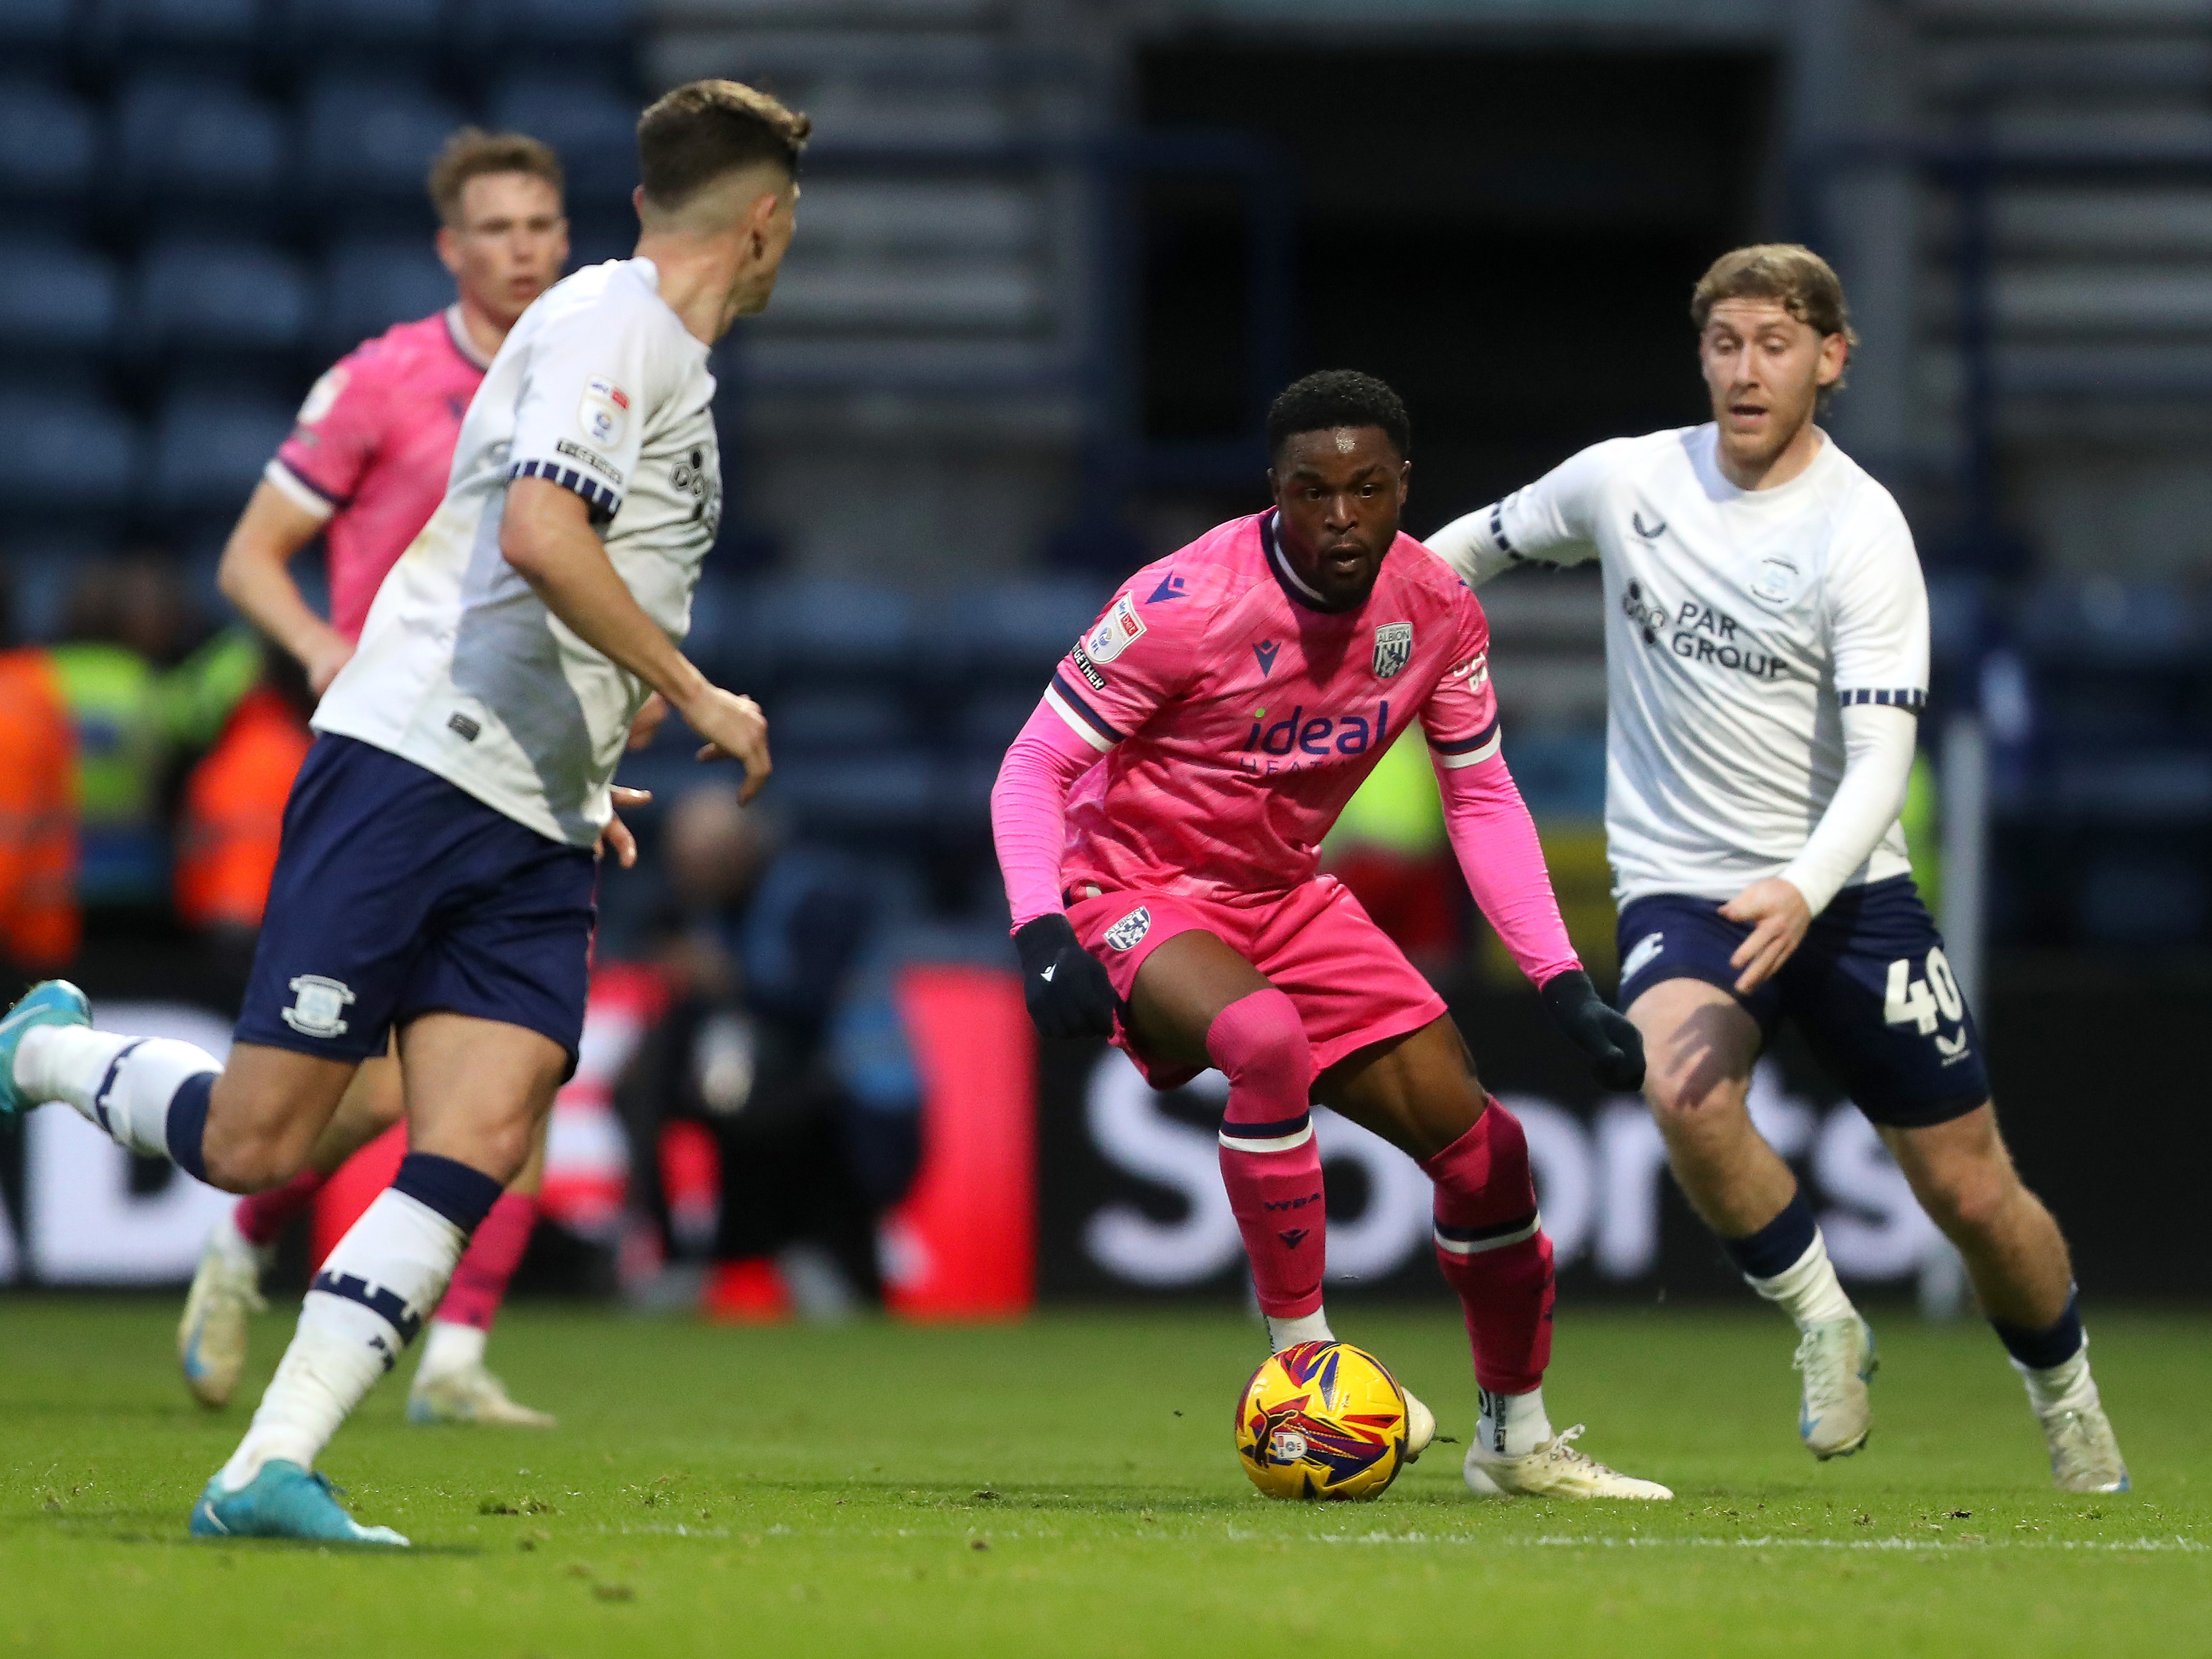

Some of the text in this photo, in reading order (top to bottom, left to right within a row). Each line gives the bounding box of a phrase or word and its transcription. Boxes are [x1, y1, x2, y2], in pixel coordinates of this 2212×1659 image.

[1123, 615, 1136, 635] bet
[1677, 601, 1737, 639] PAR
[1073, 642, 1105, 689] GETHER
[1090, 639, 1100, 655] EFL
[1672, 631, 1788, 679] GROUP
[1241, 700, 1389, 755] ideal
[1885, 947, 1964, 1035] 40
[1081, 1039, 1936, 1312] Spors
